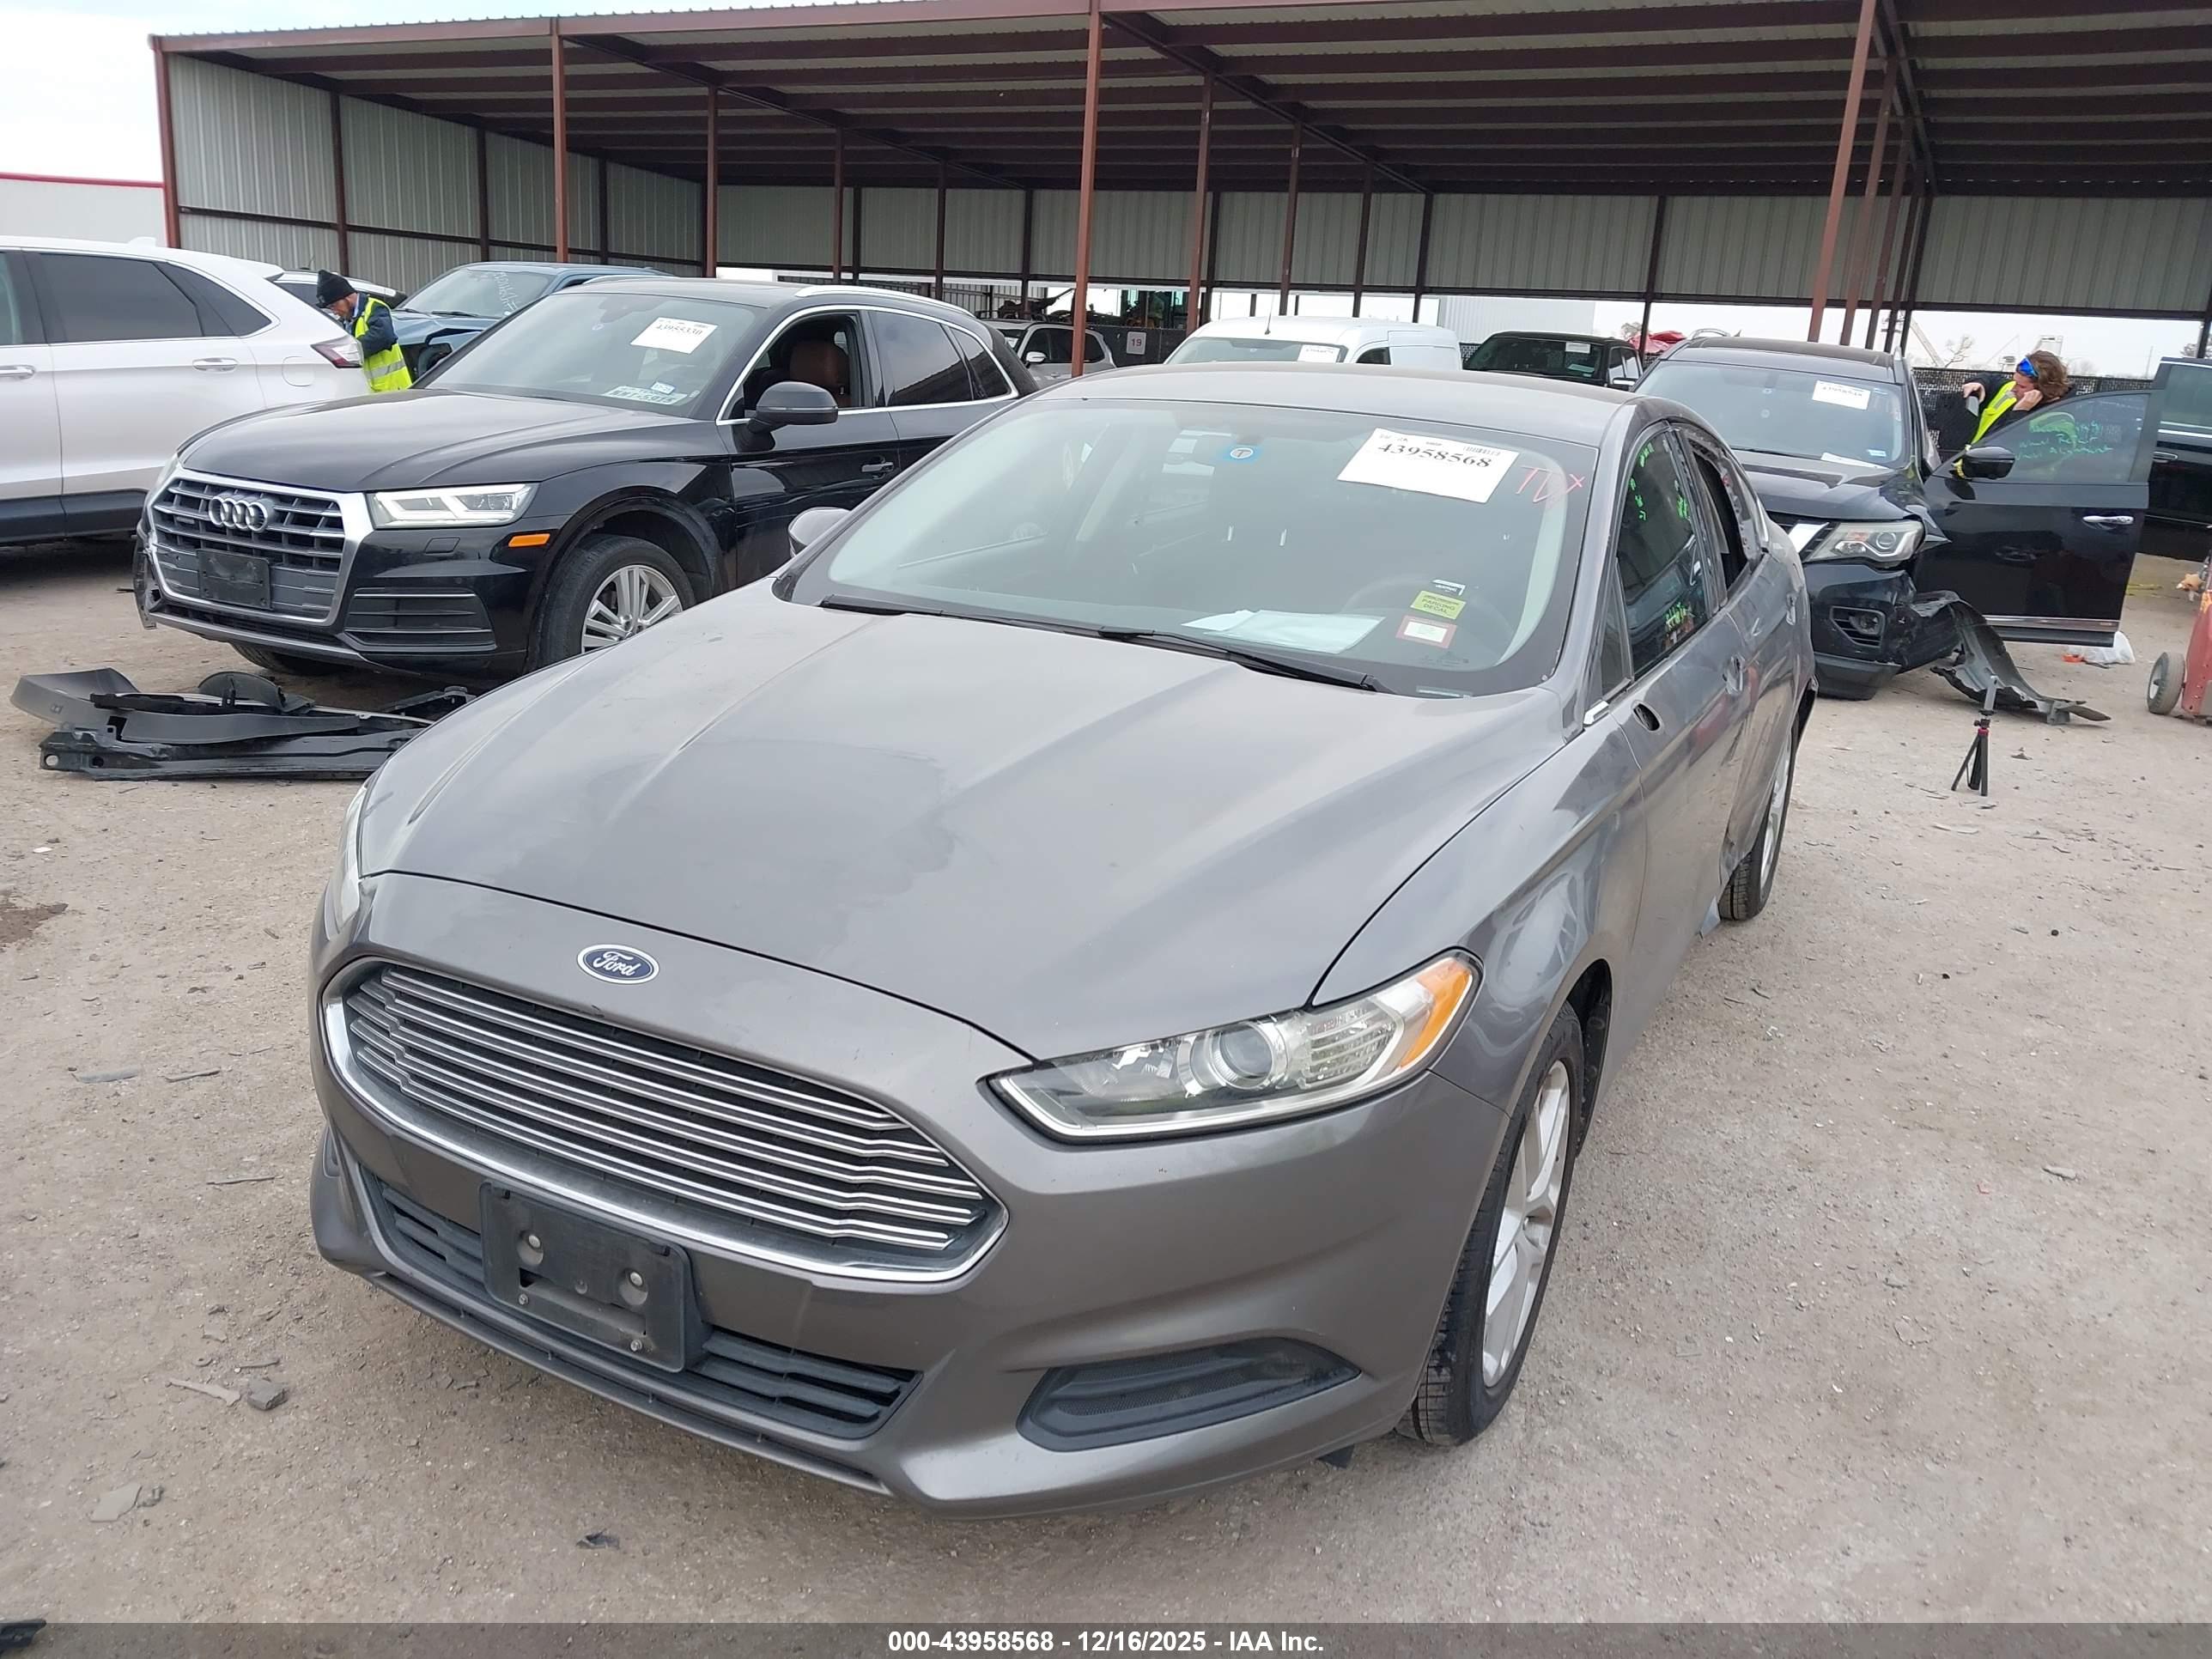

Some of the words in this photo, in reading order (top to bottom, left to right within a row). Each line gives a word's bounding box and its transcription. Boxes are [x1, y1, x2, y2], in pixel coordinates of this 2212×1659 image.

[1378, 443, 1492, 468] 43958568
[1423, 604, 1448, 614] DECAL
[592, 951, 641, 976] Ford
